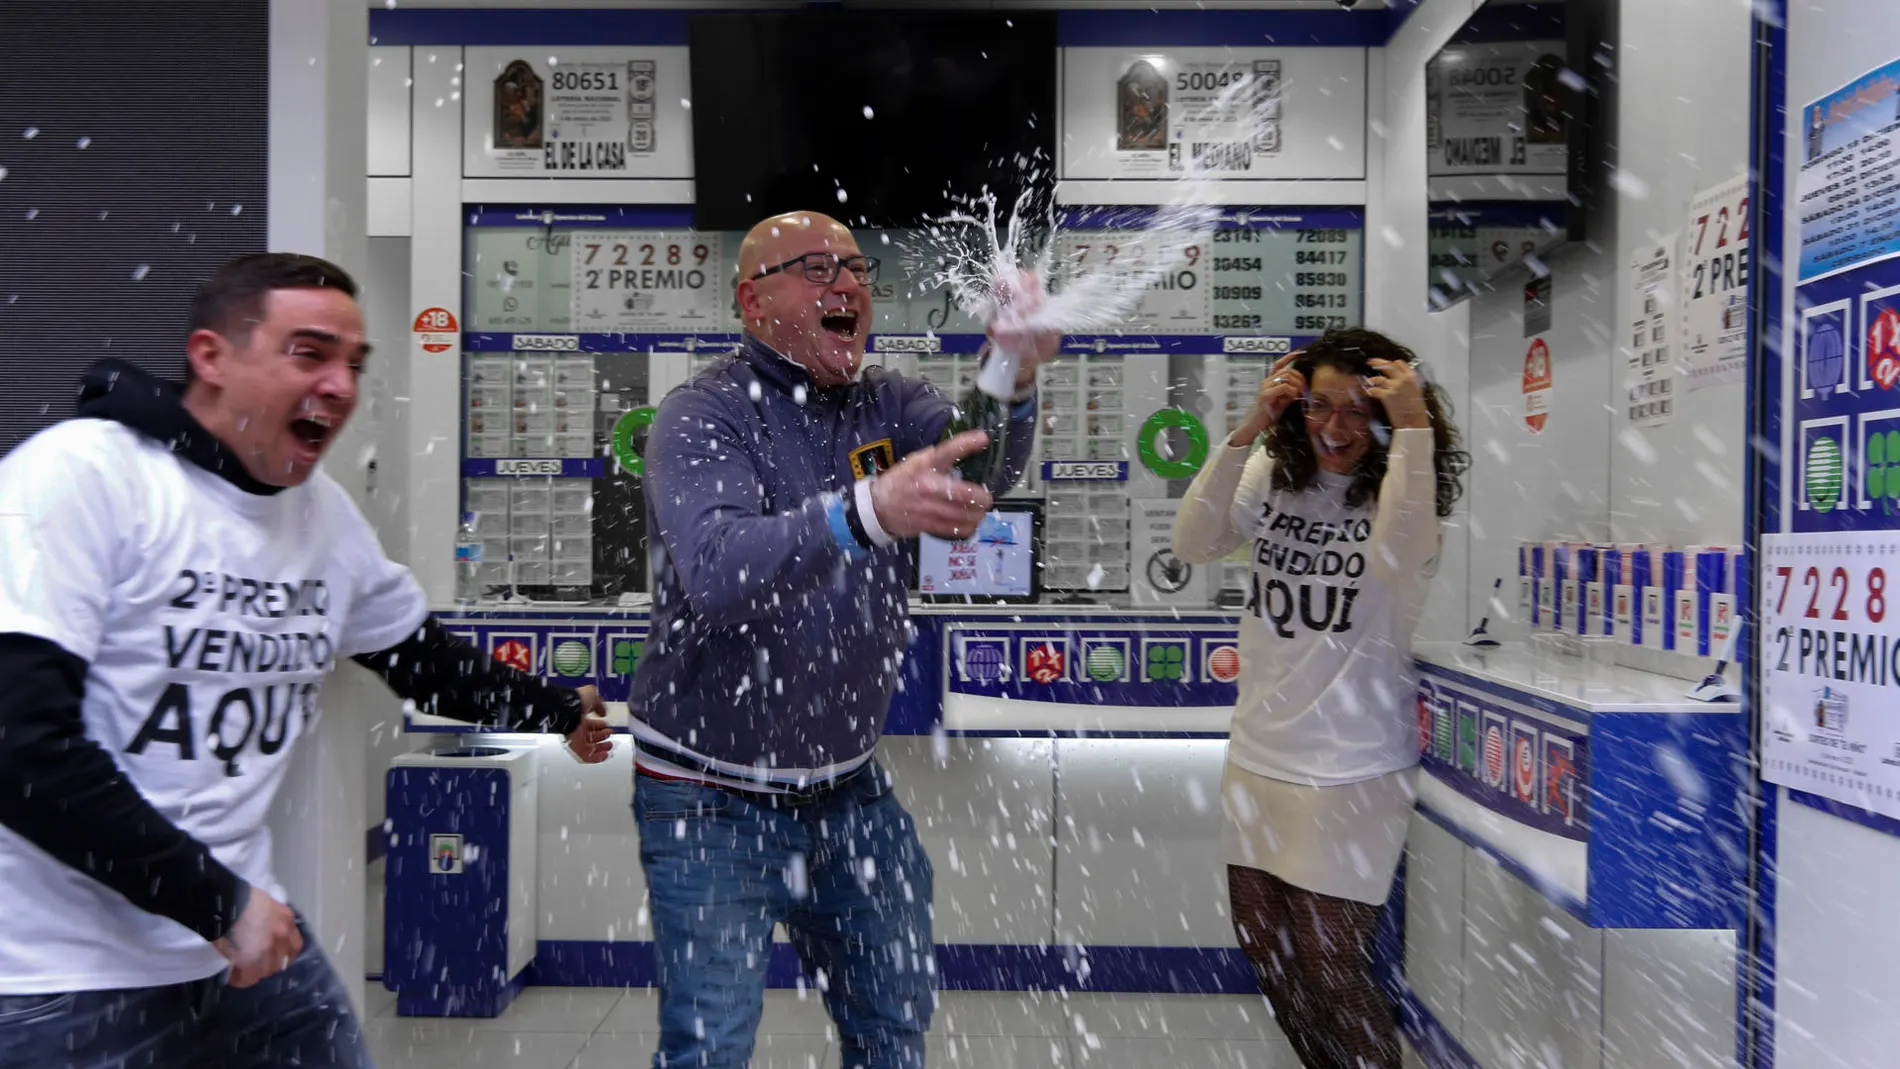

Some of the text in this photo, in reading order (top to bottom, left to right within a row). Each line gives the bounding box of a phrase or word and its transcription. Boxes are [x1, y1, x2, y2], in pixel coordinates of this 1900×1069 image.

[552, 72, 619, 91] 80651
[545, 142, 558, 170] EL
[561, 142, 575, 170] DE
[579, 142, 594, 170] LA
[597, 142, 627, 170] CASA
[584, 244, 709, 266] 72289
[1296, 251, 1347, 264] 84417
[609, 269, 705, 290] PREMIO
[1296, 272, 1347, 286] 85930
[421, 311, 449, 327] +18
[500, 461, 560, 473] JUEVES
[1055, 464, 1117, 476] JUEVES
[1246, 572, 1360, 639] AQUÍ
[163, 625, 332, 673] VENDIDO
